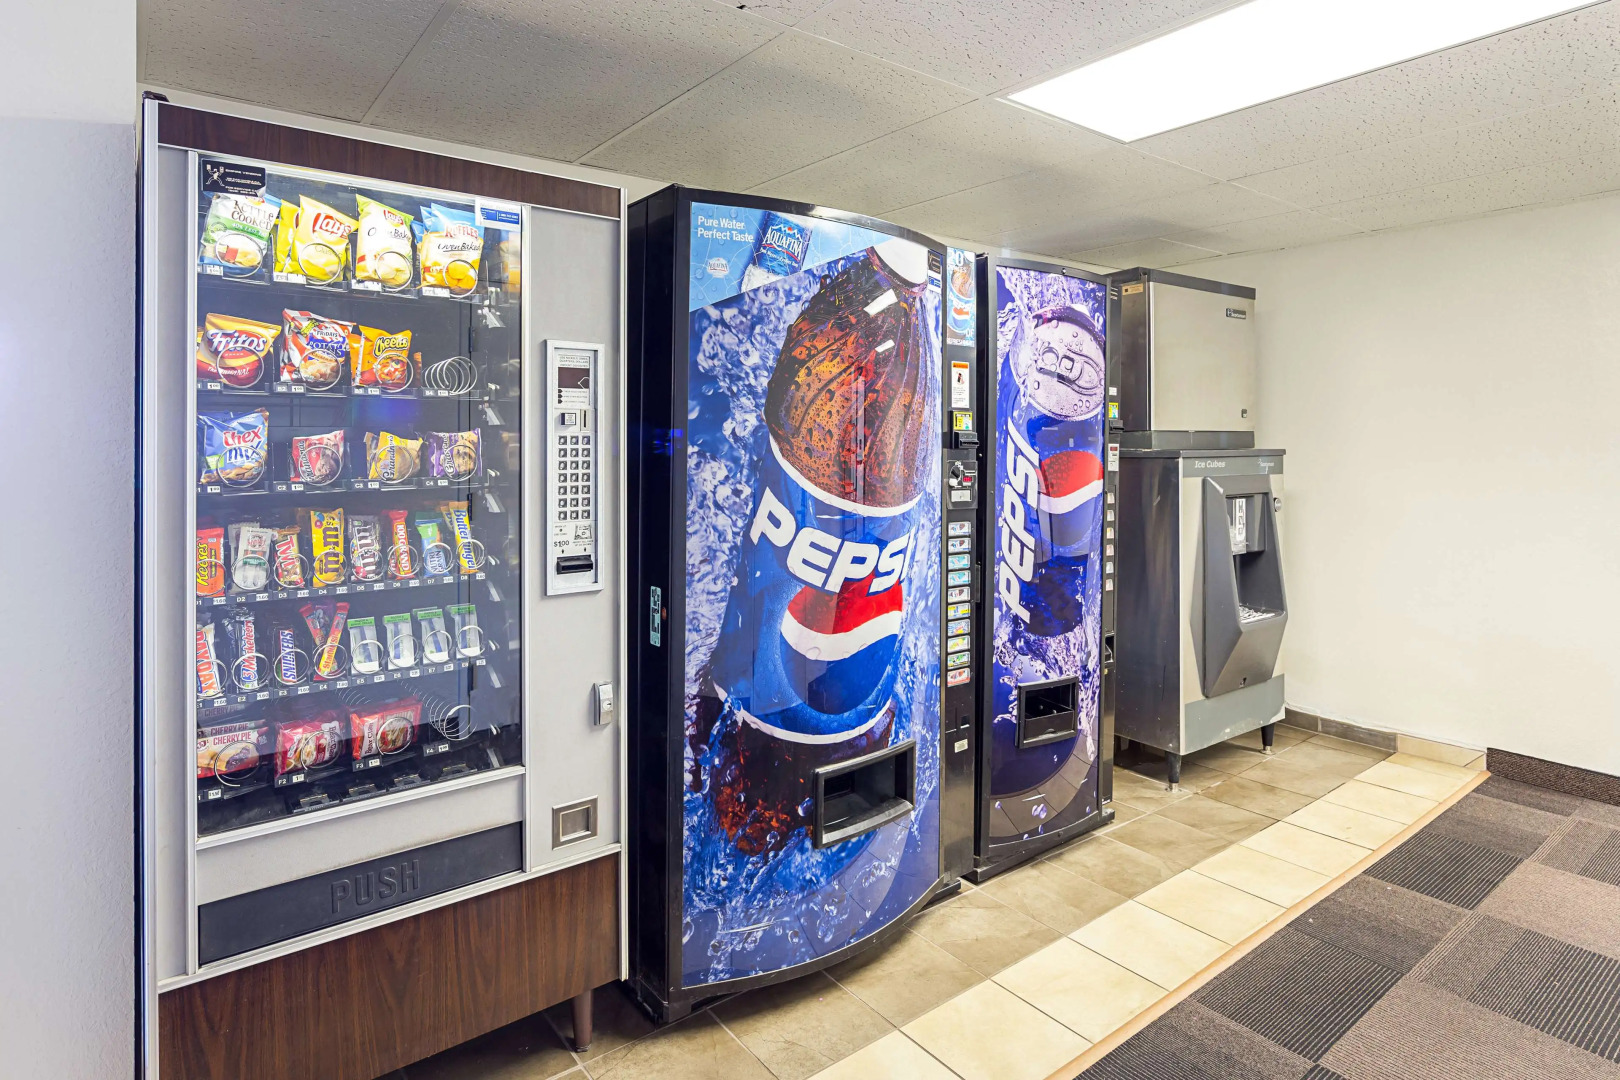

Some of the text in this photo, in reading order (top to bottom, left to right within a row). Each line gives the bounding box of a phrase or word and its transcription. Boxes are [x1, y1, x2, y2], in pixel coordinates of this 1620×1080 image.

[698, 216, 744, 229] Pure Water
[698, 228, 730, 240] Perfect
[762, 228, 803, 262] AQUAFINA
[207, 329, 267, 352] Fritos
[223, 425, 263, 446] Chex
[1206, 460, 1226, 468] Cubes
[998, 416, 1040, 624] PEPSI
[750, 486, 916, 594] PEPSI
[197, 543, 208, 586] Reese's
[398, 539, 410, 571] GRAND
[280, 630, 297, 680] SNICKERS
[242, 669, 255, 682] 3
[211, 723, 237, 736] CHERRY
[213, 733, 240, 746] CHERRY
[241, 731, 251, 740] PIE
[331, 860, 420, 914] PUSH
